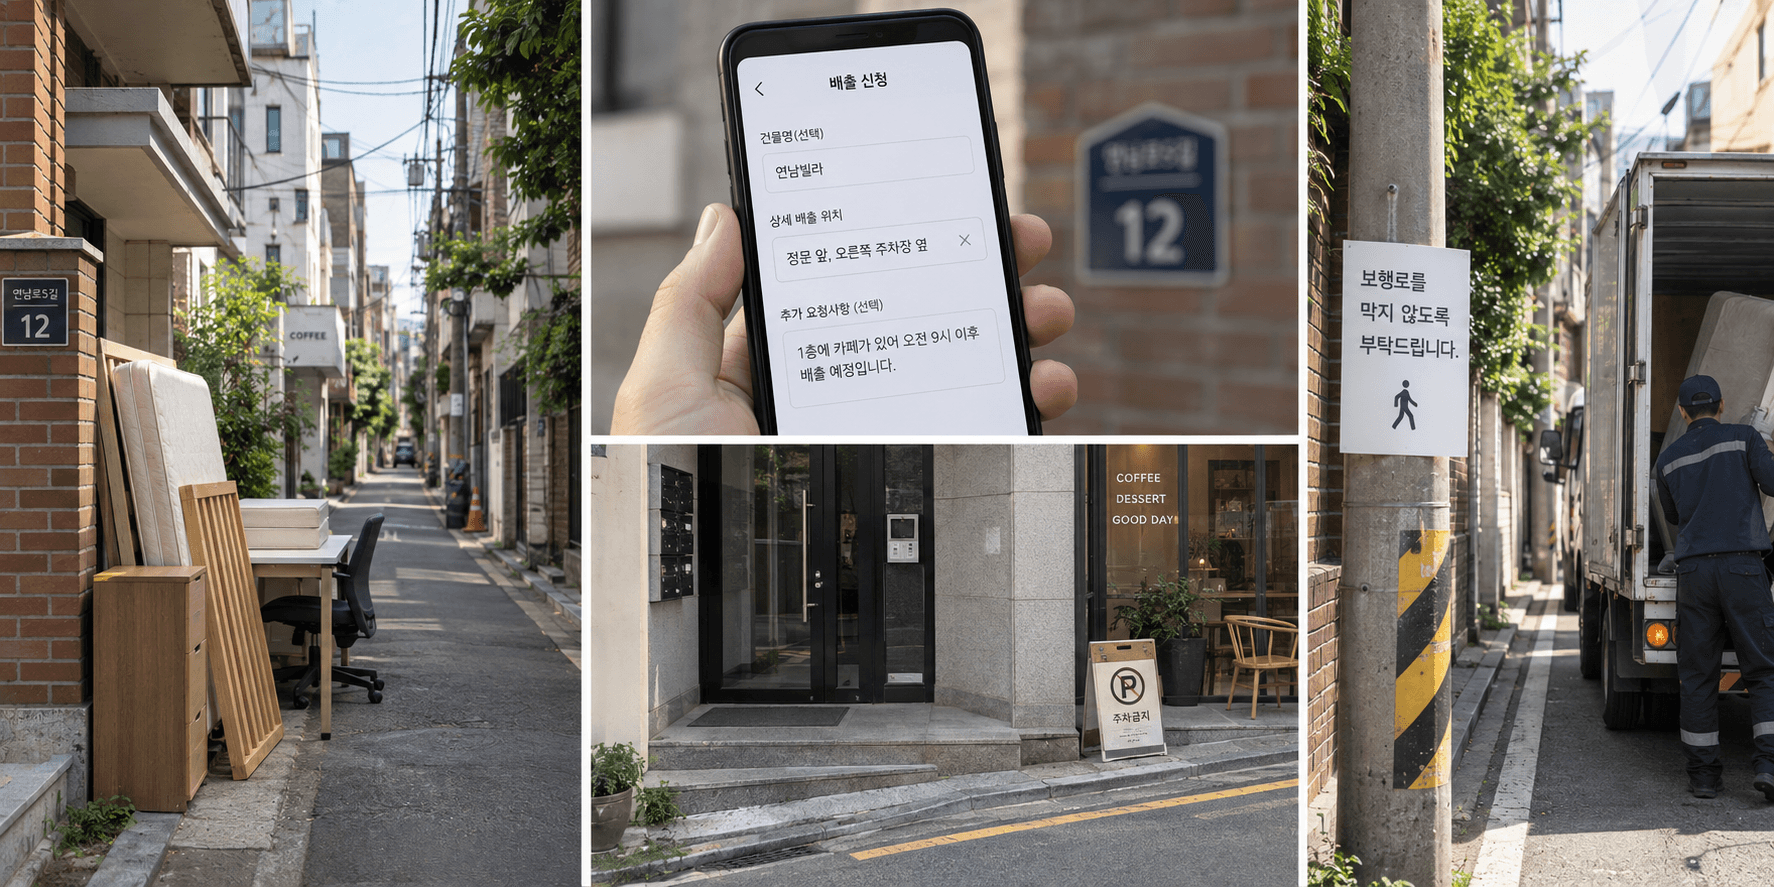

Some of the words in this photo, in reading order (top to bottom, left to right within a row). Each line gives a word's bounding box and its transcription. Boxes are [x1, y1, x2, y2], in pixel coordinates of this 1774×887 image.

[829, 74, 857, 91] 배출
[861, 71, 888, 89] 신청
[775, 162, 823, 180] 연남빌라
[769, 214, 792, 228] 상세
[795, 211, 817, 225] 배출
[821, 208, 843, 222] 위치
[1115, 199, 1184, 264] 12
[786, 250, 812, 266] 정문
[815, 247, 832, 263] 앞,
[835, 243, 872, 260] 오른쪽
[876, 239, 911, 256] 주차장
[915, 237, 928, 252] 옆
[1360, 270, 1426, 292] 보행로를
[780, 308, 803, 322] 추가
[806, 302, 850, 318] 요청사항
[1361, 302, 1393, 323] 막지
[1401, 304, 1450, 327] 않도록
[20, 313, 50, 339] 12
[290, 331, 327, 340] COFFEE
[797, 343, 830, 360] 1층에
[833, 337, 871, 356] 카페가
[874, 335, 899, 351] 있어
[903, 331, 927, 347] 오전
[931, 328, 951, 344] 9시
[955, 325, 980, 341] 이후
[1359, 335, 1459, 359] 부탁드립니다.
[800, 366, 826, 383] 배출
[829, 358, 896, 379] 예정입니다.
[1116, 473, 1161, 483] COFFEE
[1116, 494, 1166, 504] DESSERT
[1112, 515, 1147, 524] GOOD
[1151, 515, 1173, 524] DAY
[1121, 675, 1137, 699] P
[1112, 710, 1150, 724] 주차금지
